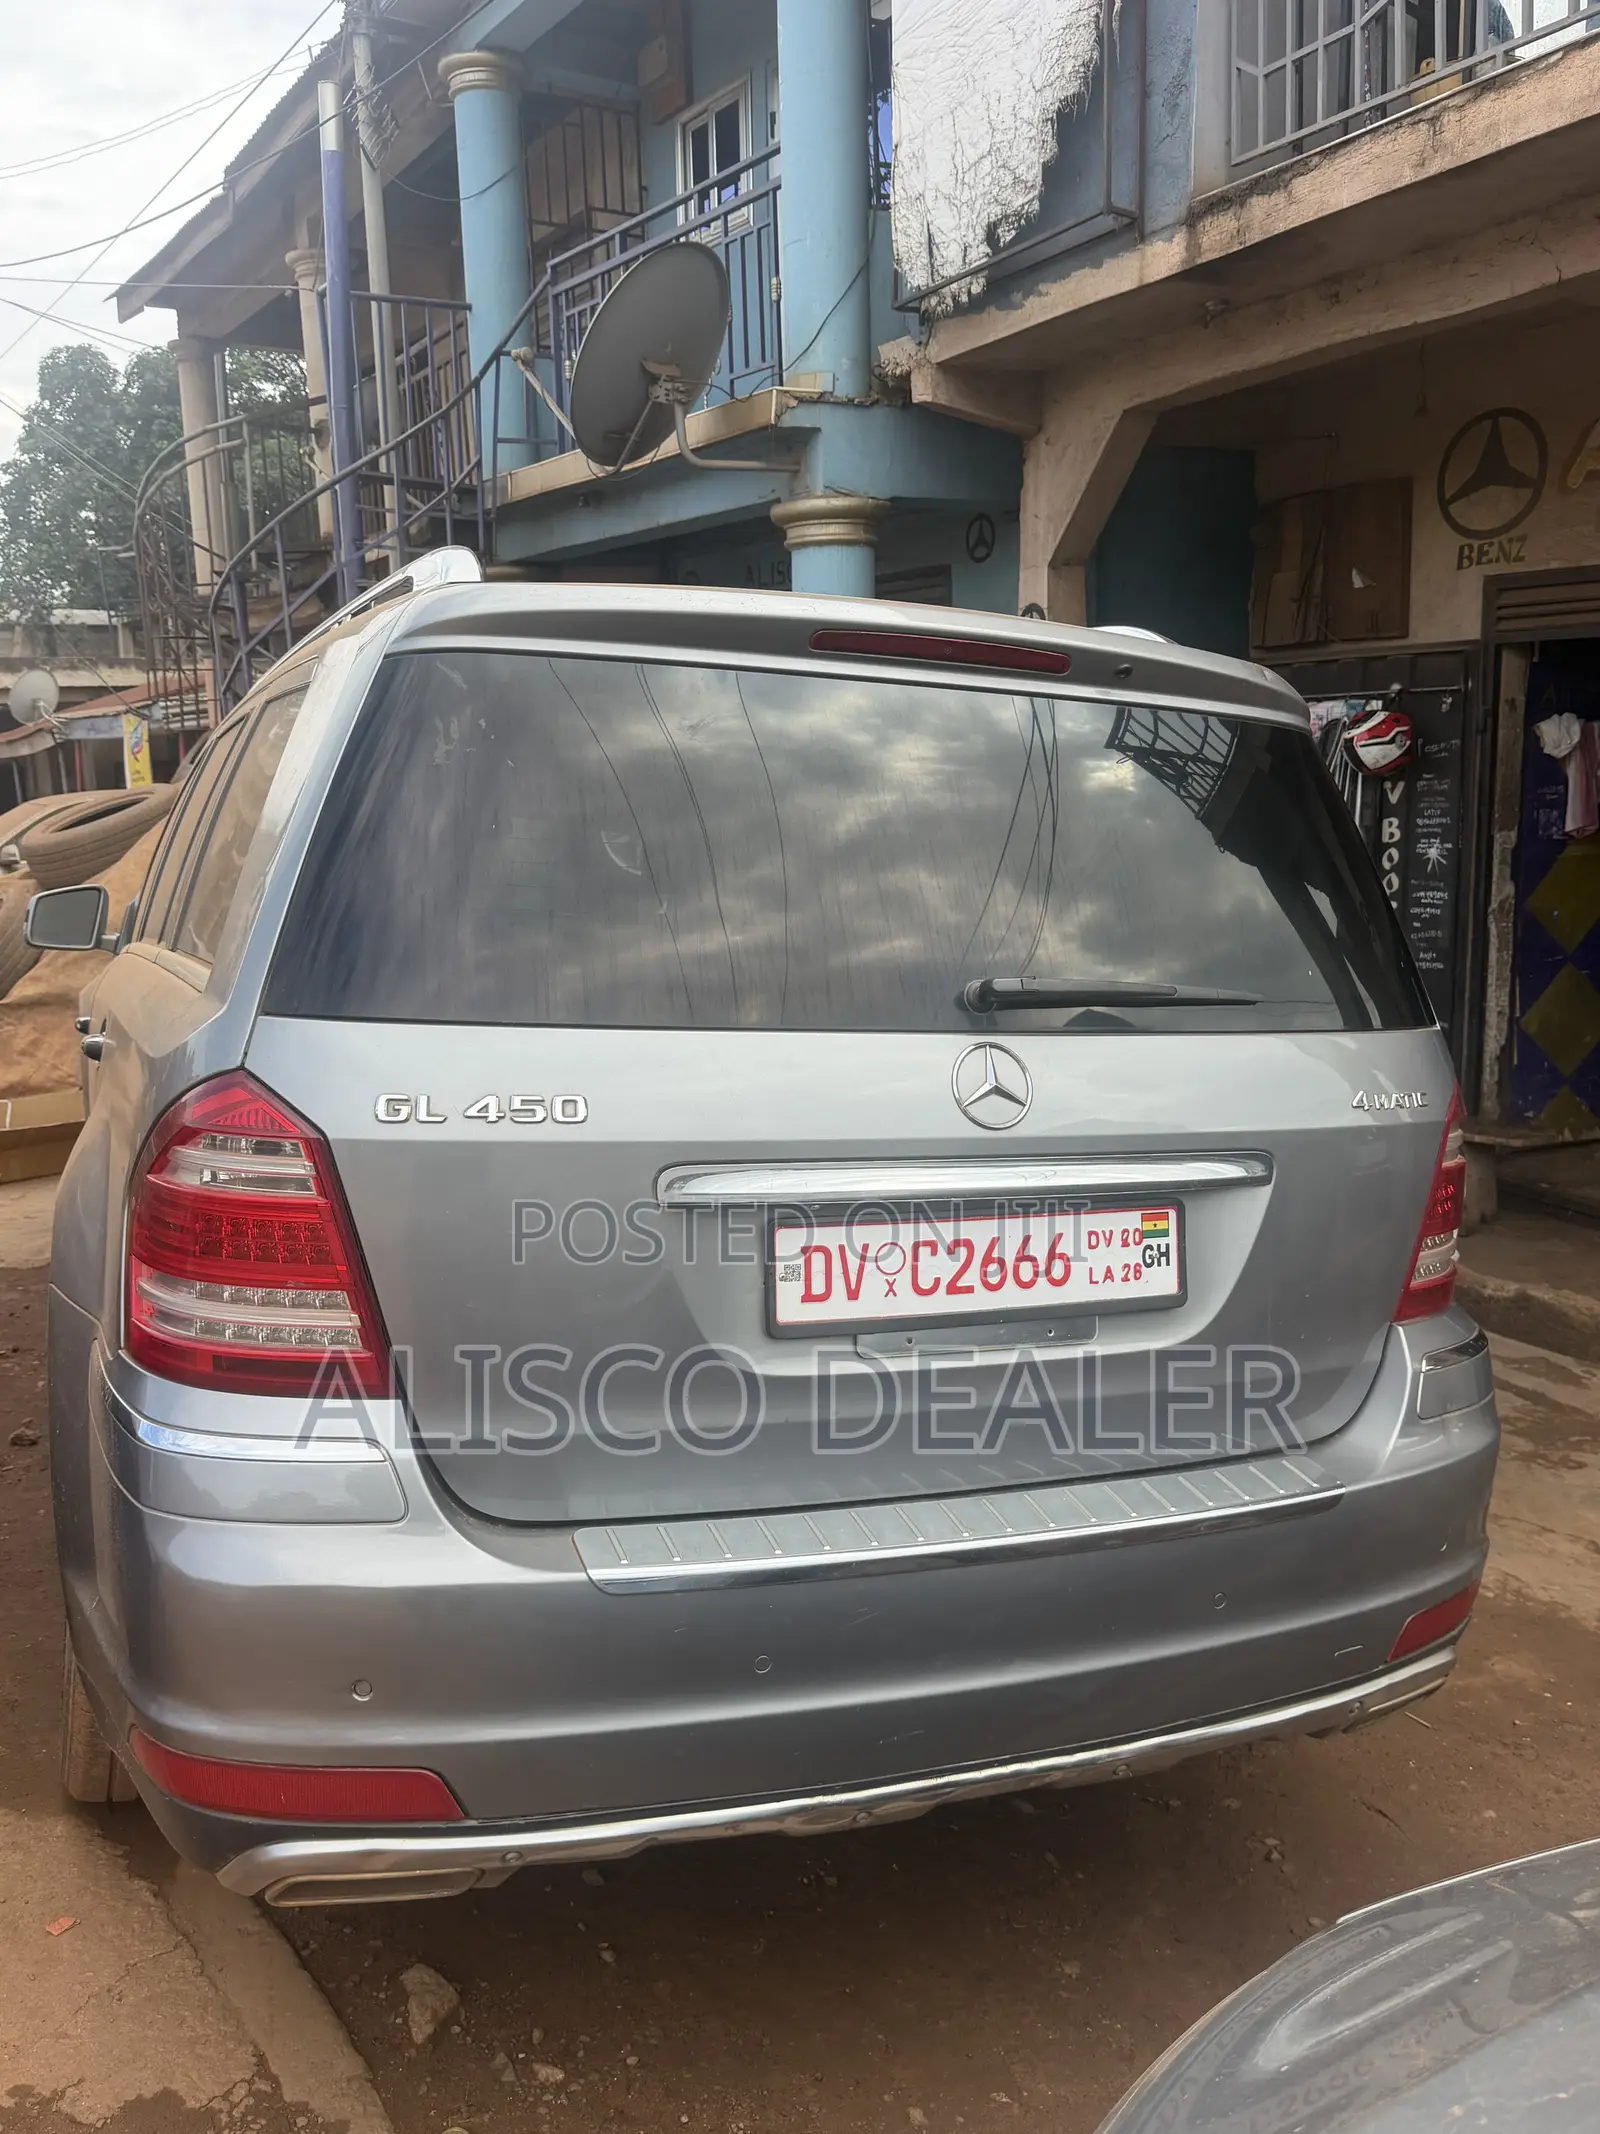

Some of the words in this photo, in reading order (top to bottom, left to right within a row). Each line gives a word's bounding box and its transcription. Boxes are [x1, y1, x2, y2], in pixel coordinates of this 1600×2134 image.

[1456, 534, 1528, 571] BENZ
[375, 1093, 448, 1123] GL
[463, 1093, 589, 1123] 450
[1087, 1228, 1114, 1250] DV
[1120, 1227, 1144, 1248] 20
[800, 1243, 870, 1303] DV
[911, 1232, 1072, 1296] C2666
[1141, 1243, 1171, 1269] GH
[1088, 1265, 1115, 1285] LA
